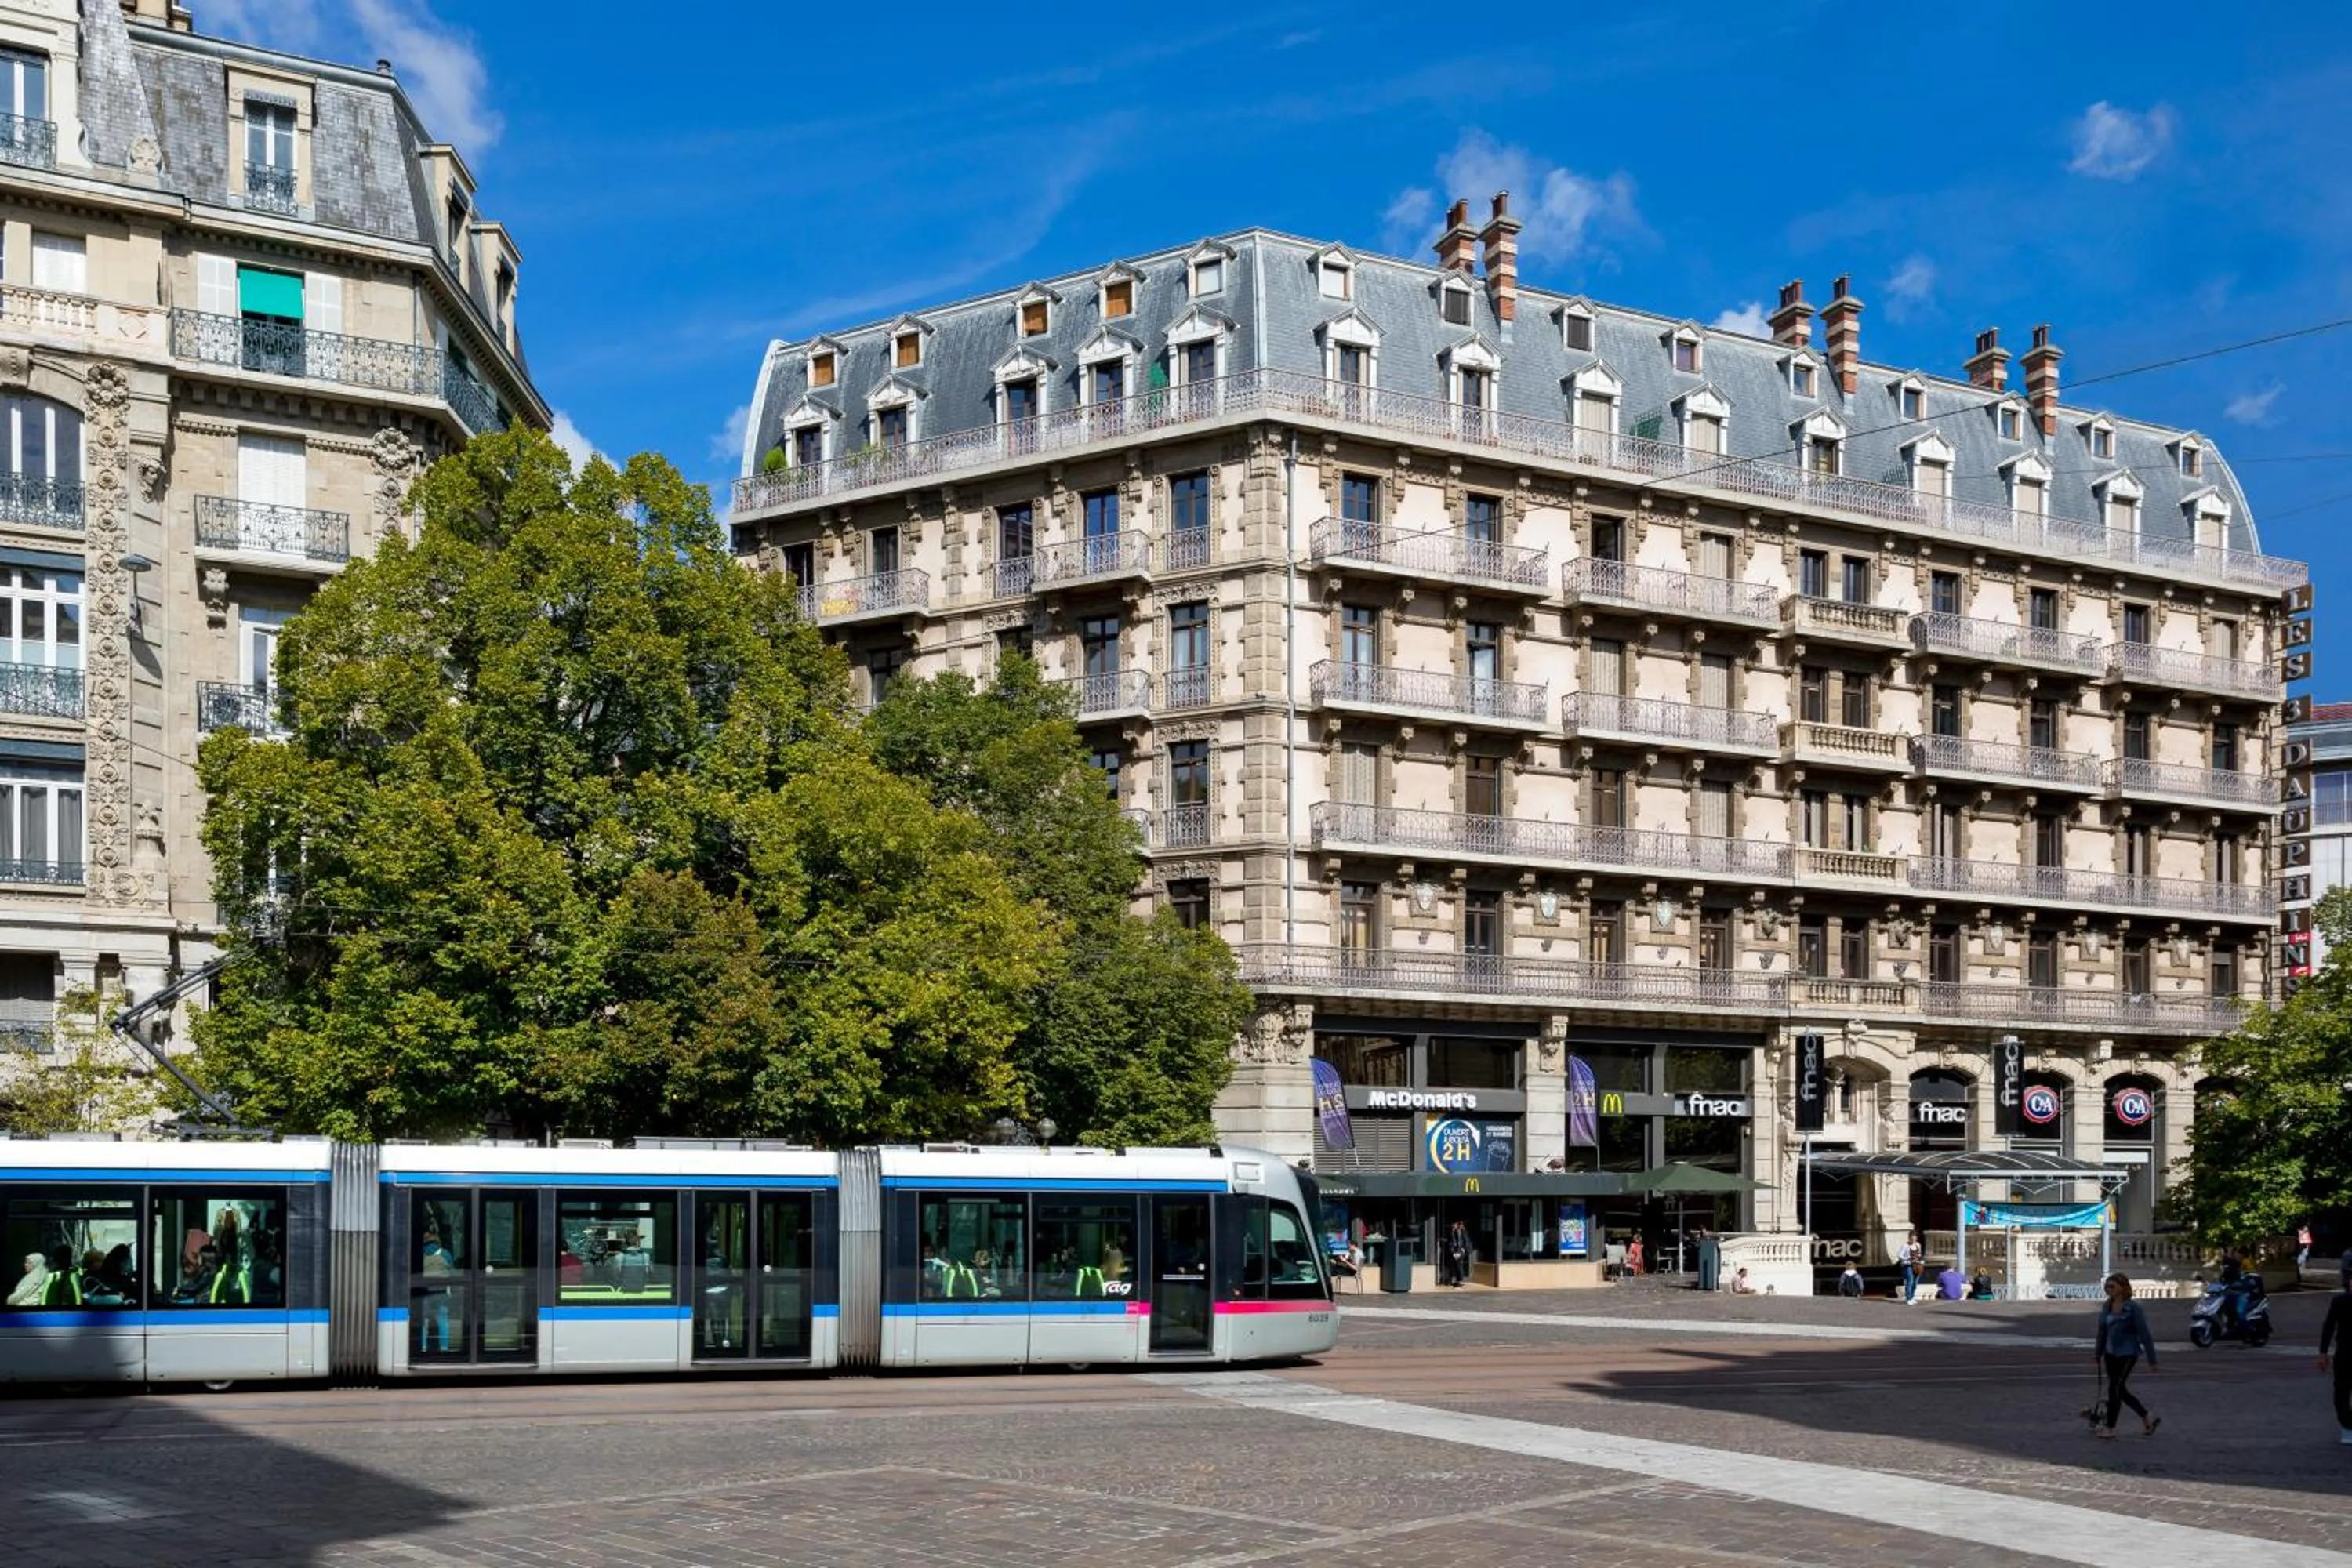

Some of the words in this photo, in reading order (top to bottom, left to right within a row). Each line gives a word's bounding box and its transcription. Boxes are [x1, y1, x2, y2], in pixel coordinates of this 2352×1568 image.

[2286, 589, 2309, 678] LES
[2285, 700, 2301, 721] 3
[1801, 1026, 1817, 1101] fnac
[2001, 1036, 2019, 1107] fnac
[1367, 1091, 1477, 1109] McDonald's
[1689, 1094, 1741, 1115] fnac
[1918, 1102, 1965, 1122] fnac
[1443, 1142, 1454, 1161] 2
[1457, 1142, 1470, 1161] H
